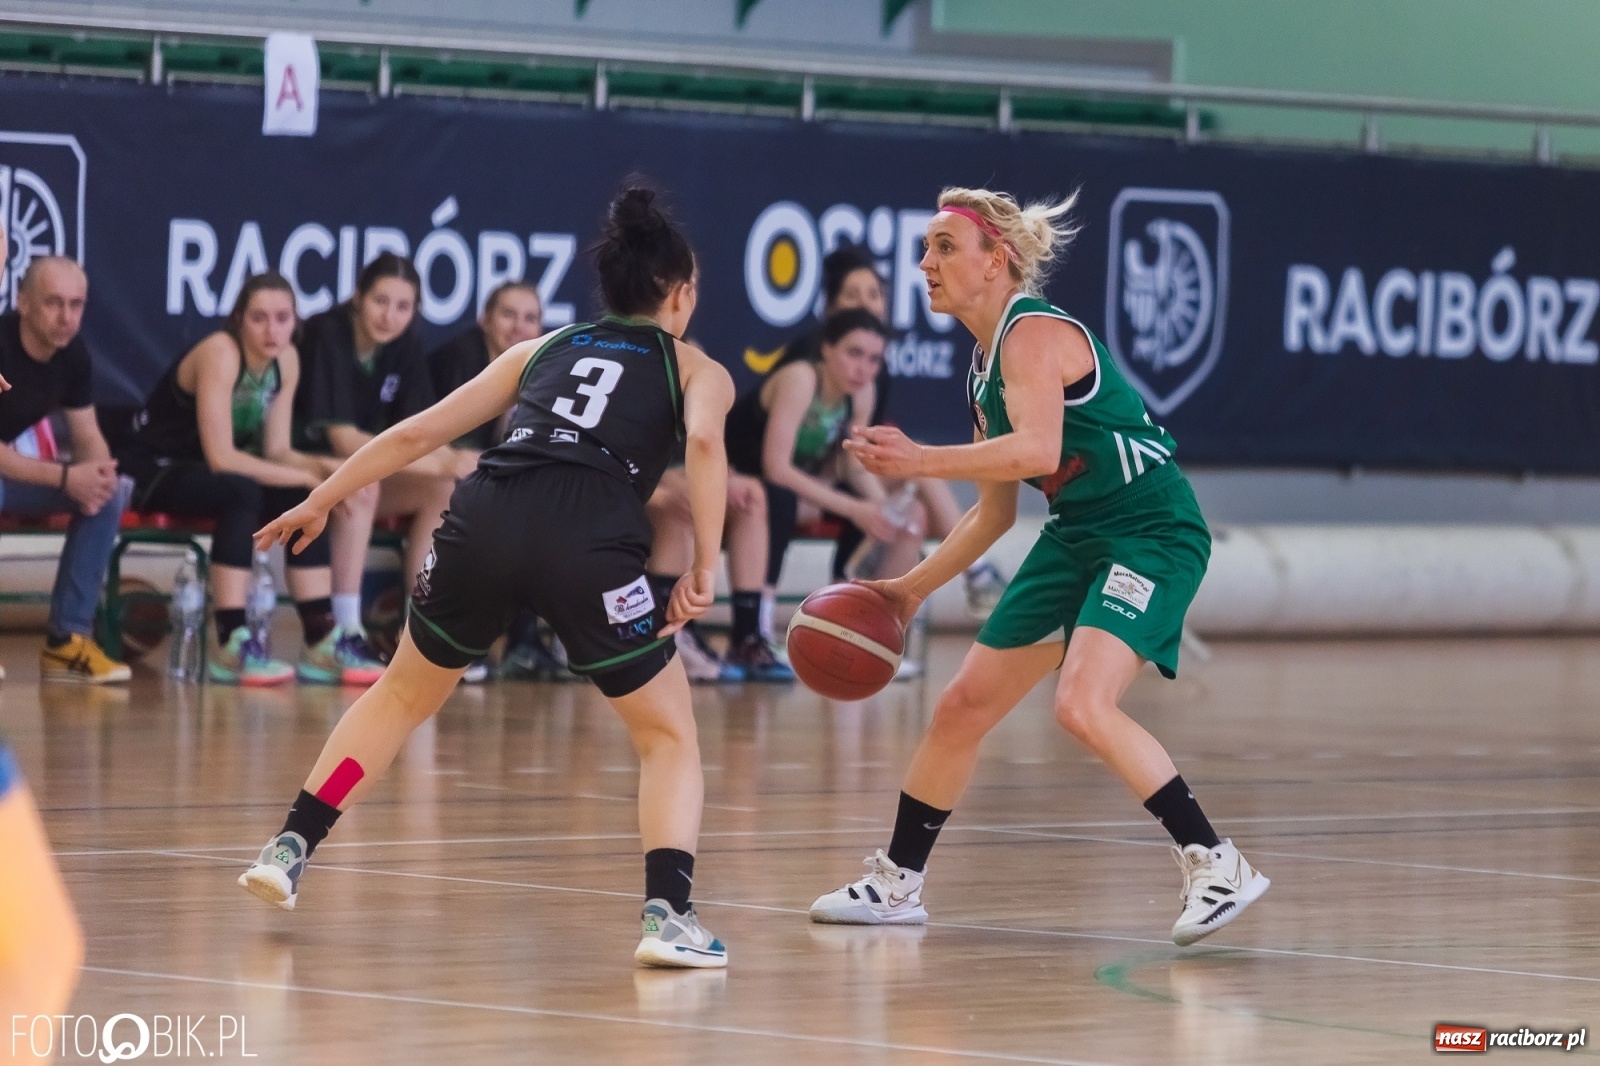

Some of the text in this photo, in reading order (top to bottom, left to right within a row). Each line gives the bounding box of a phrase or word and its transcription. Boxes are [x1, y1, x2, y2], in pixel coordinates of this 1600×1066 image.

[275, 64, 304, 113] A
[1283, 246, 1600, 365] RACIBÓRZ
[551, 357, 625, 430] 3
